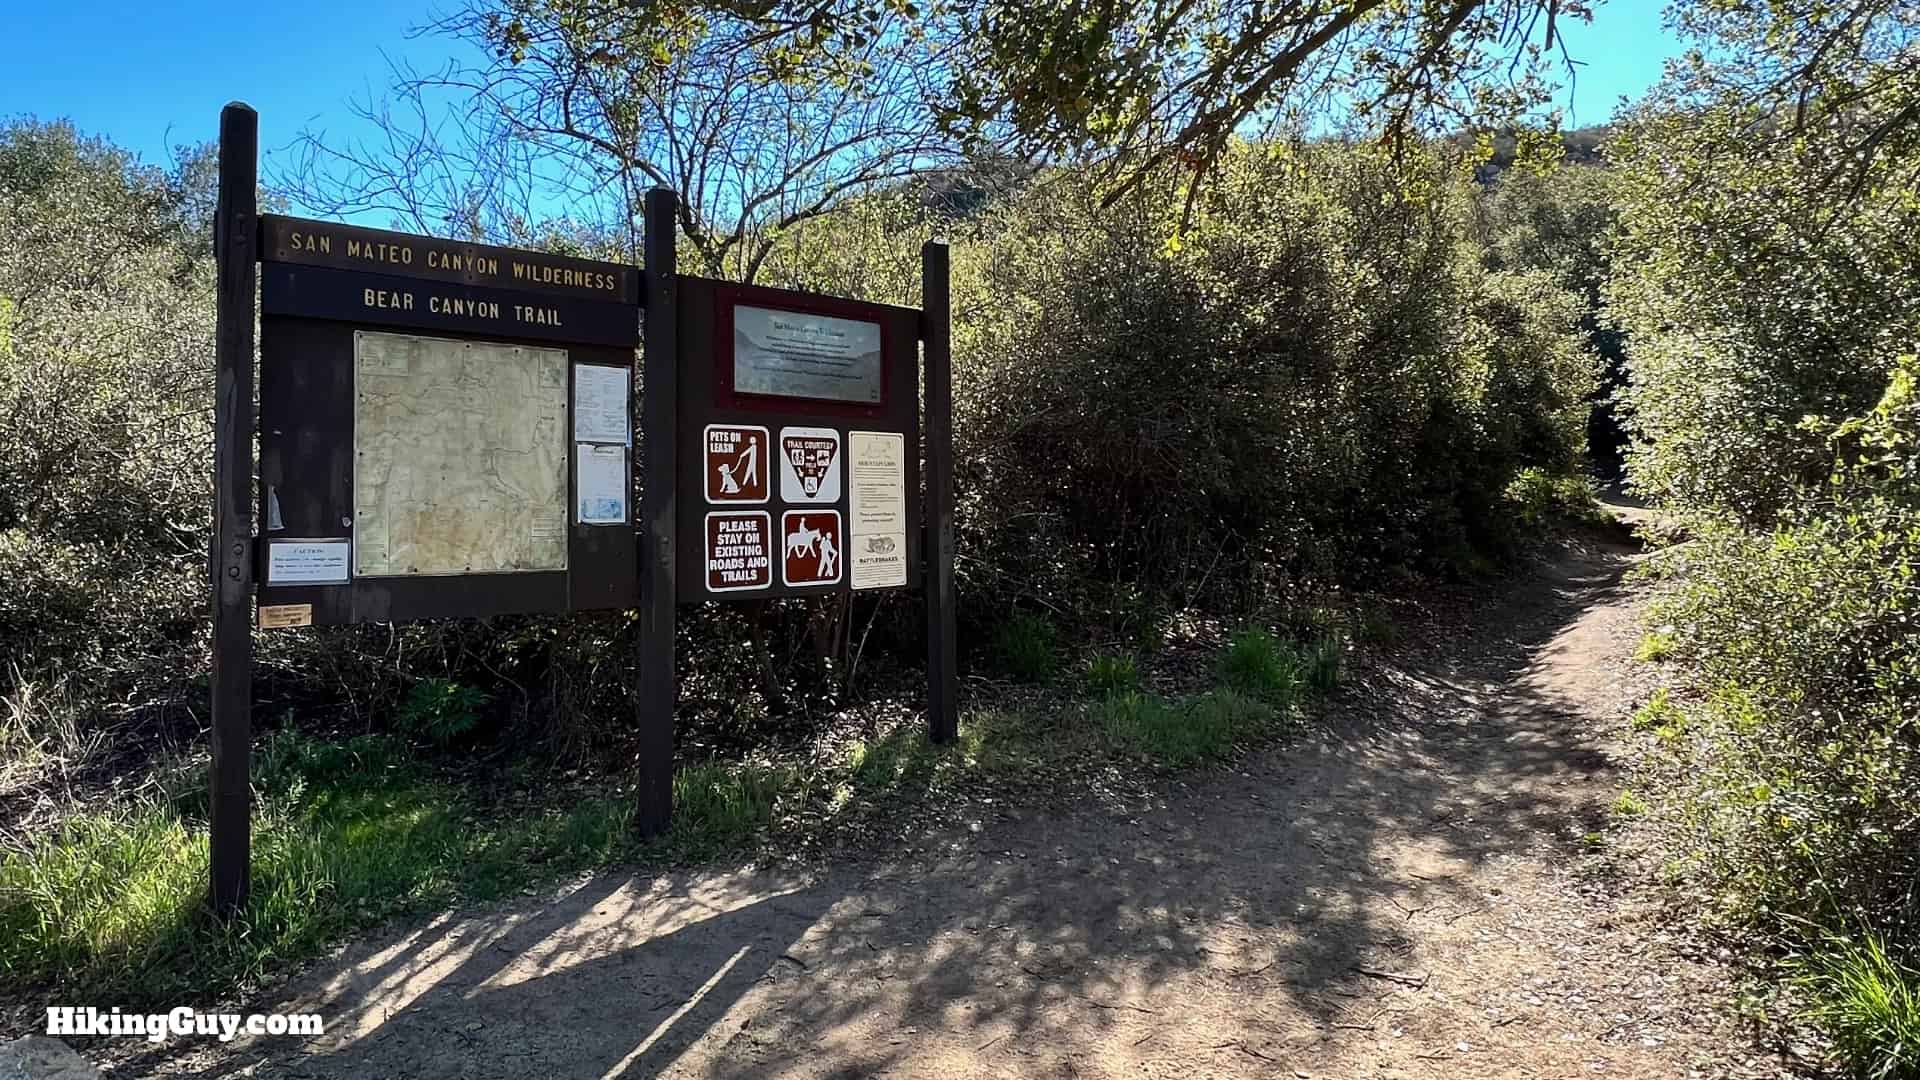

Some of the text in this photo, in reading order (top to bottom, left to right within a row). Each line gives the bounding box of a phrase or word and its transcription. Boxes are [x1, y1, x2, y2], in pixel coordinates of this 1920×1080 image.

[290, 232, 616, 291] SAN MATEO CANYON WILDERNESS
[364, 288, 563, 326] BEAR CANYON TRAIL
[709, 431, 742, 443] PETS ON
[710, 443, 735, 454] LEASH
[787, 440, 804, 449] TRAIL
[719, 520, 758, 533] PLEASE
[717, 532, 760, 546] STAY ON
[715, 545, 763, 558] EXISTING
[710, 557, 768, 571] ROADS AND
[721, 569, 758, 582] TRAILS
